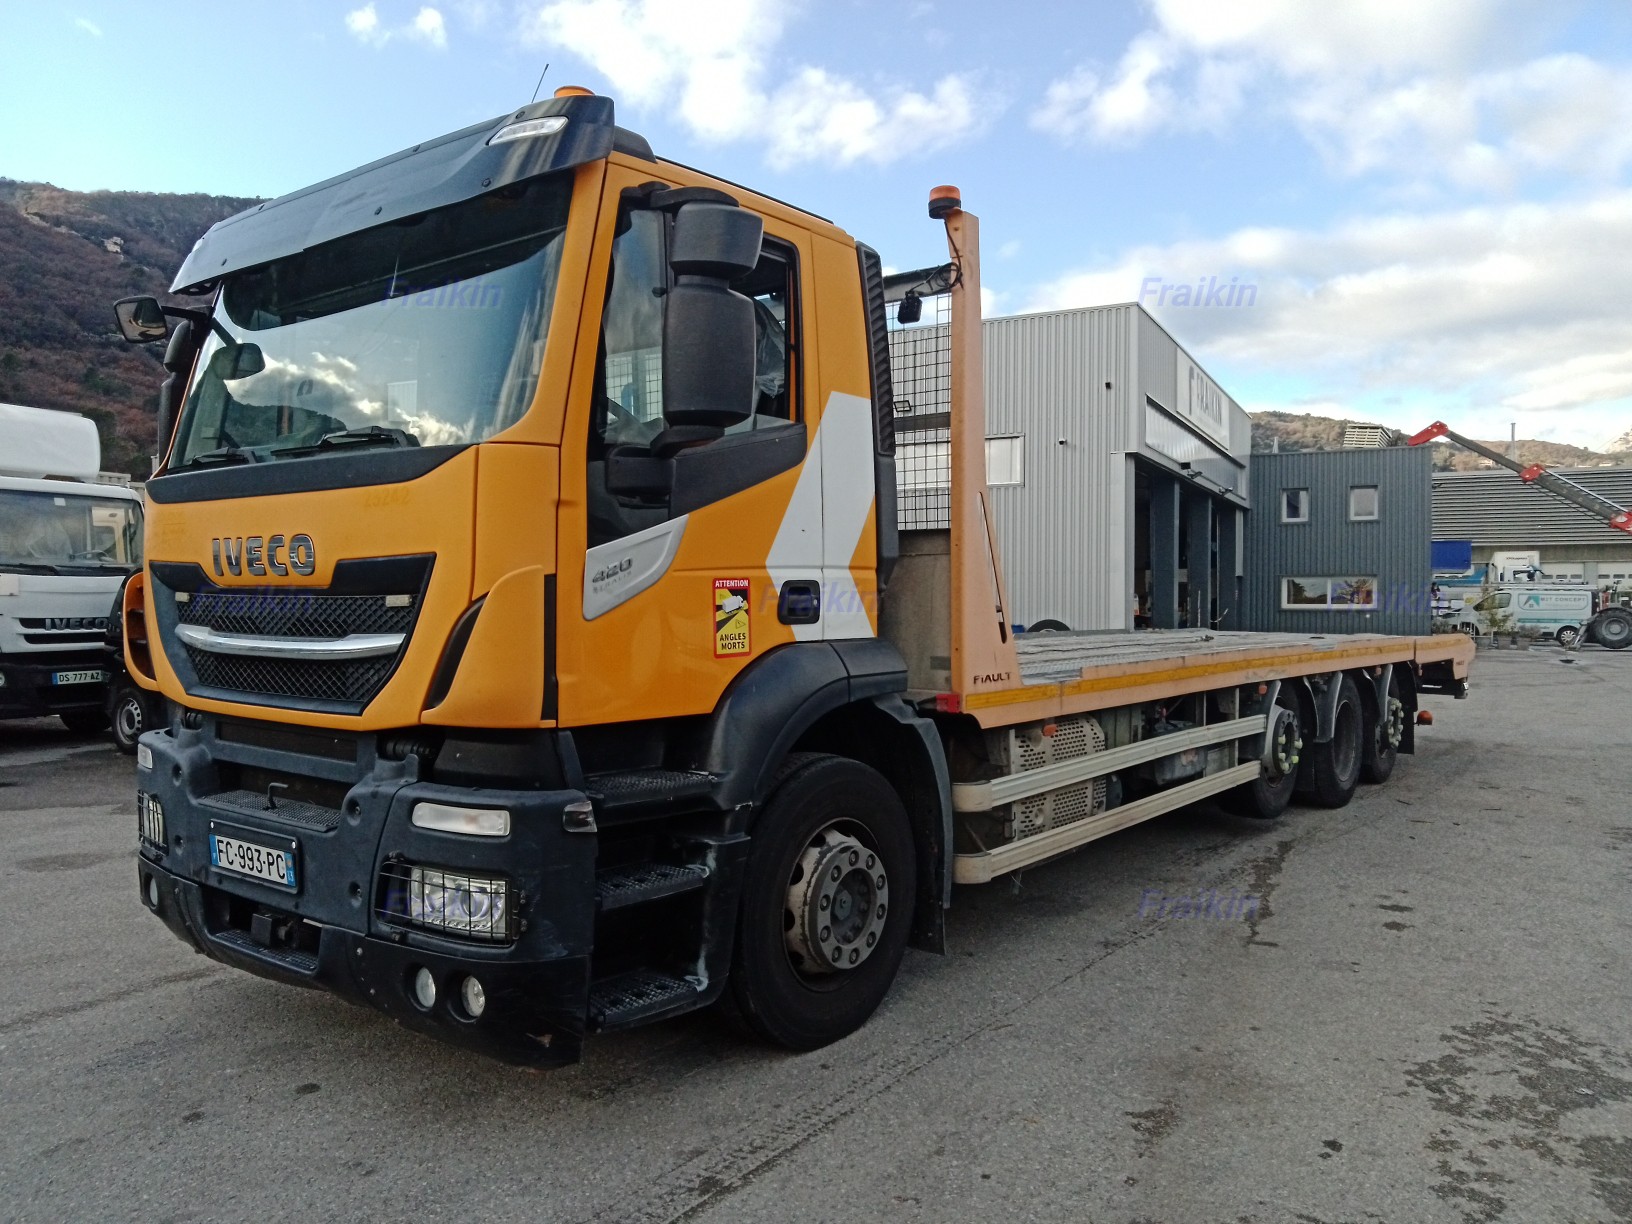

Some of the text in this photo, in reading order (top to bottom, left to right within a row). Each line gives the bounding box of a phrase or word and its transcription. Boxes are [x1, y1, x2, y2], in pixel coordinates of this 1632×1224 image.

[1196, 371, 1222, 427] FRAIKIN
[212, 533, 316, 576] IVECO
[592, 556, 633, 583] 420
[715, 579, 749, 588] ATTENTION
[45, 618, 109, 631] IVECO
[719, 632, 746, 642] ANGLES
[721, 641, 746, 651] MORTS
[58, 672, 101, 683] DS-777-AZ
[216, 839, 286, 880] FC-993-PC
